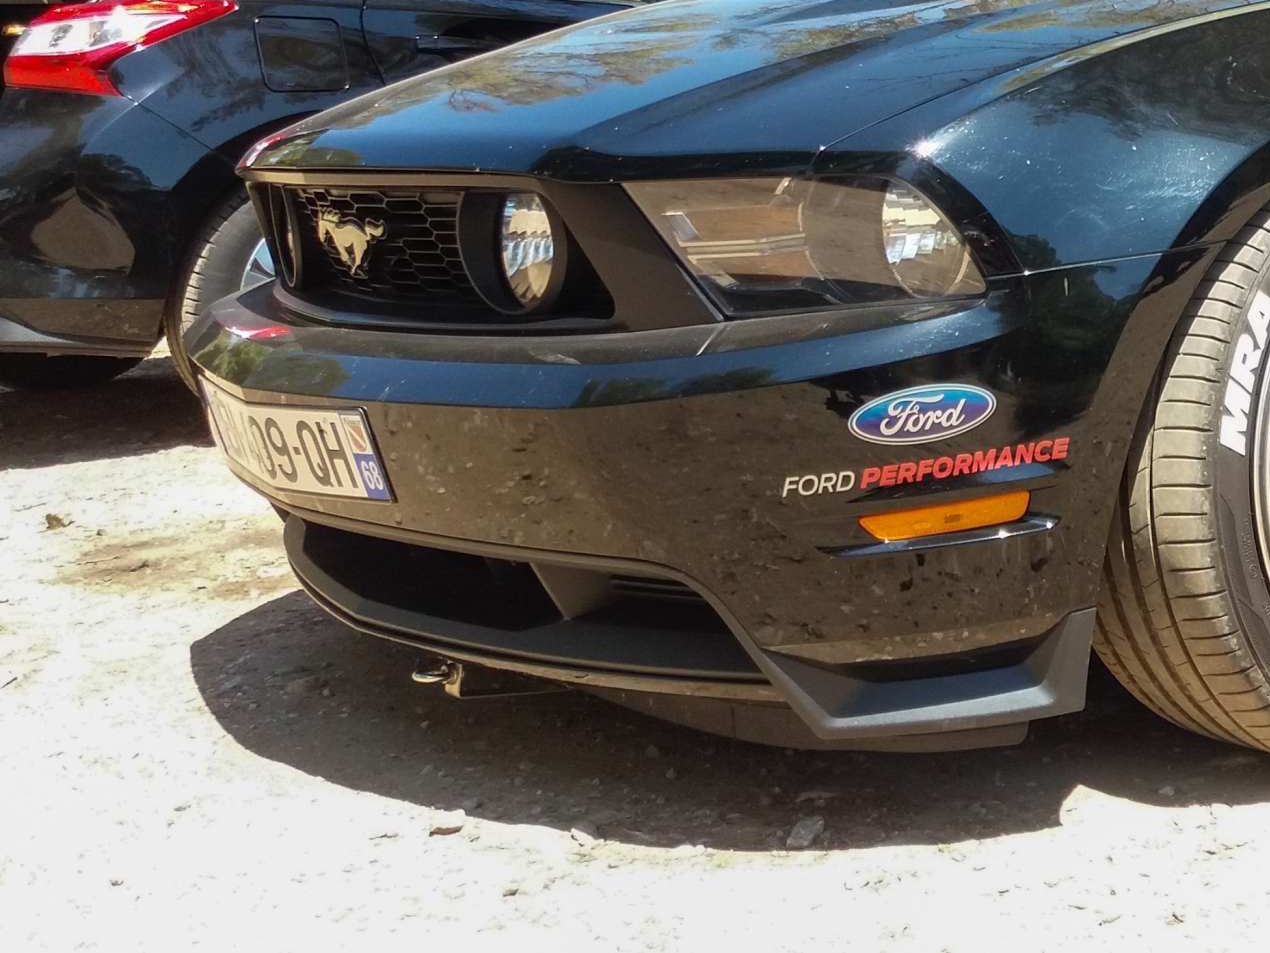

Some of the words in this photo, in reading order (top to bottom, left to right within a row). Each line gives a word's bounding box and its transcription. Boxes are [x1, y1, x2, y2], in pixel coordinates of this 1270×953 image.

[879, 394, 967, 436] Ford
[361, 460, 384, 490] 68
[782, 471, 855, 498] FORD
[860, 437, 1071, 489] PERFORMANCE
